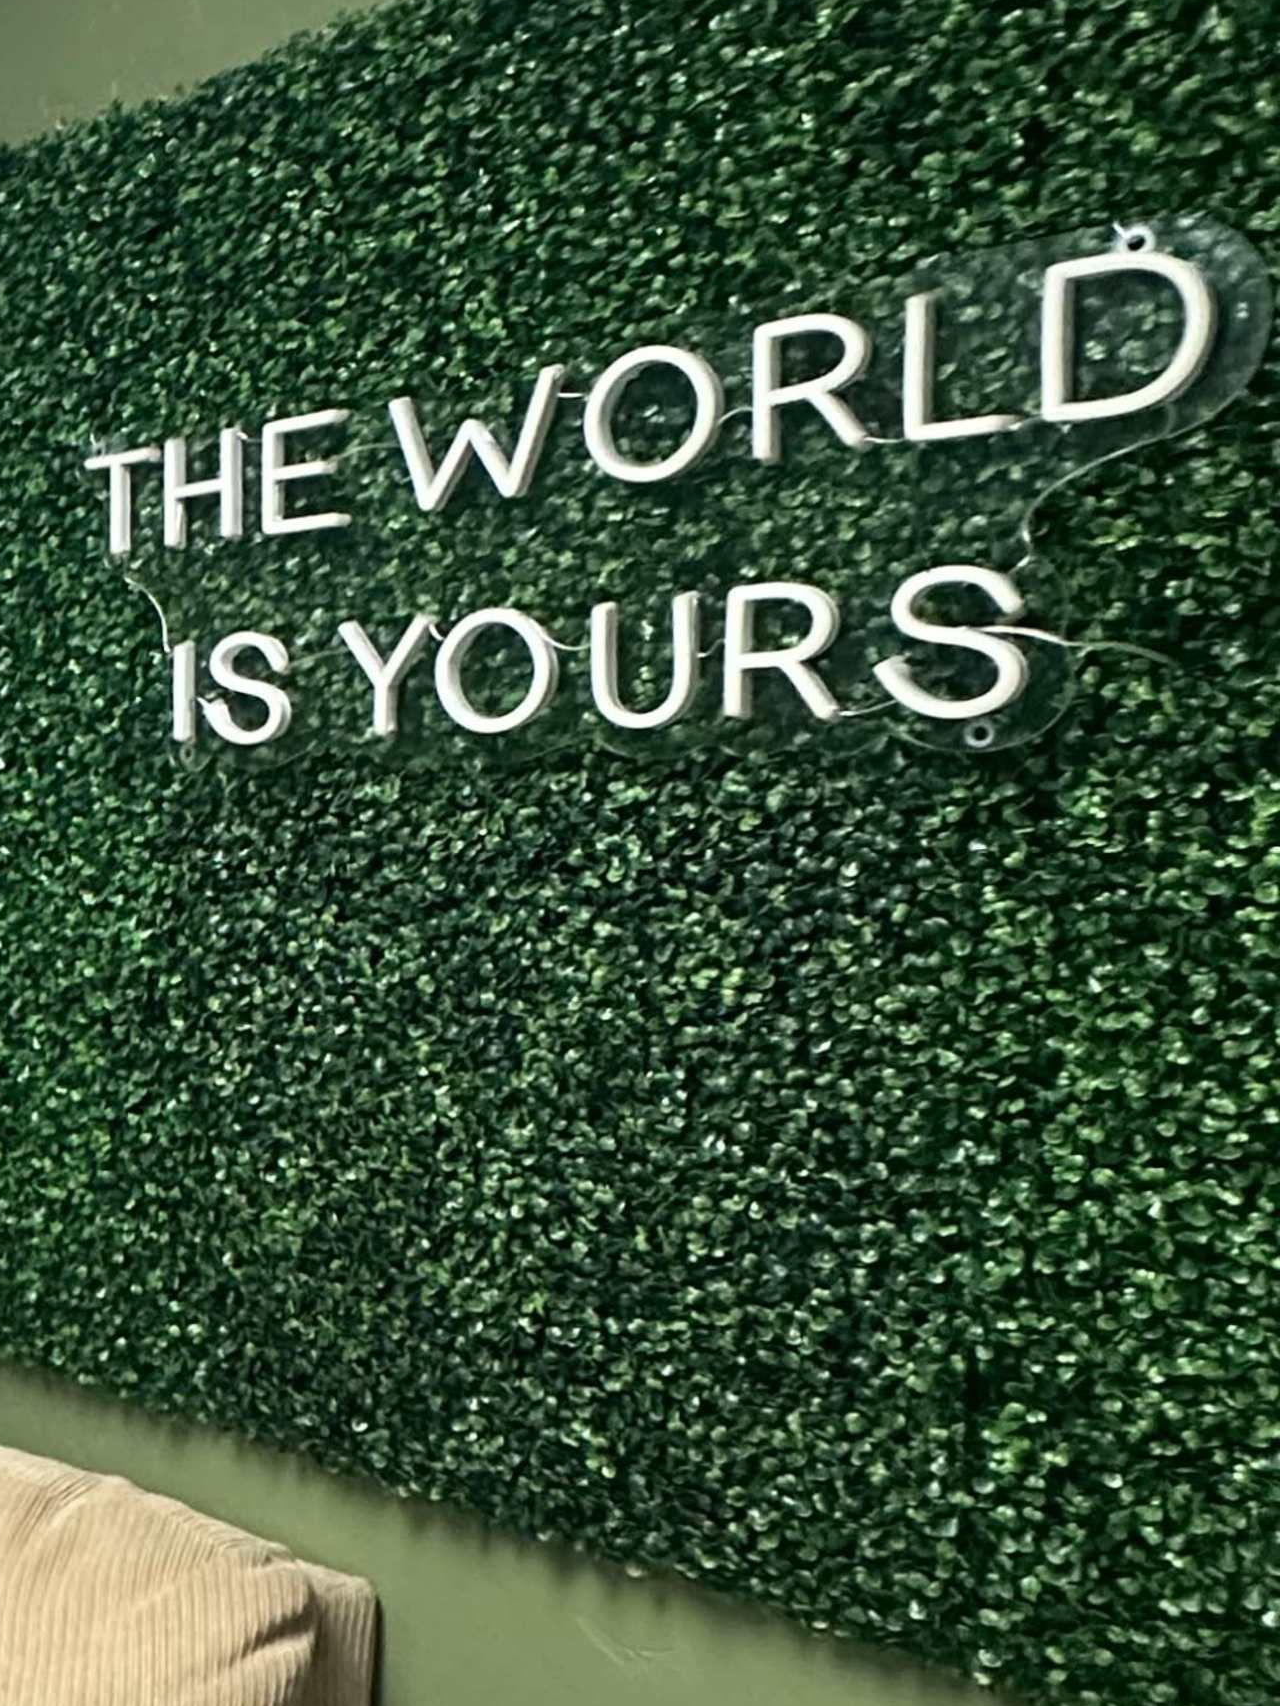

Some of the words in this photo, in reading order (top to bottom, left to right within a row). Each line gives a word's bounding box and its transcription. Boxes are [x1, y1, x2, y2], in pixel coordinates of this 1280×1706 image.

[84, 408, 352, 555] THE
[388, 250, 1217, 511] WORLD
[172, 632, 293, 746] IS
[336, 565, 1029, 736] YOURS
